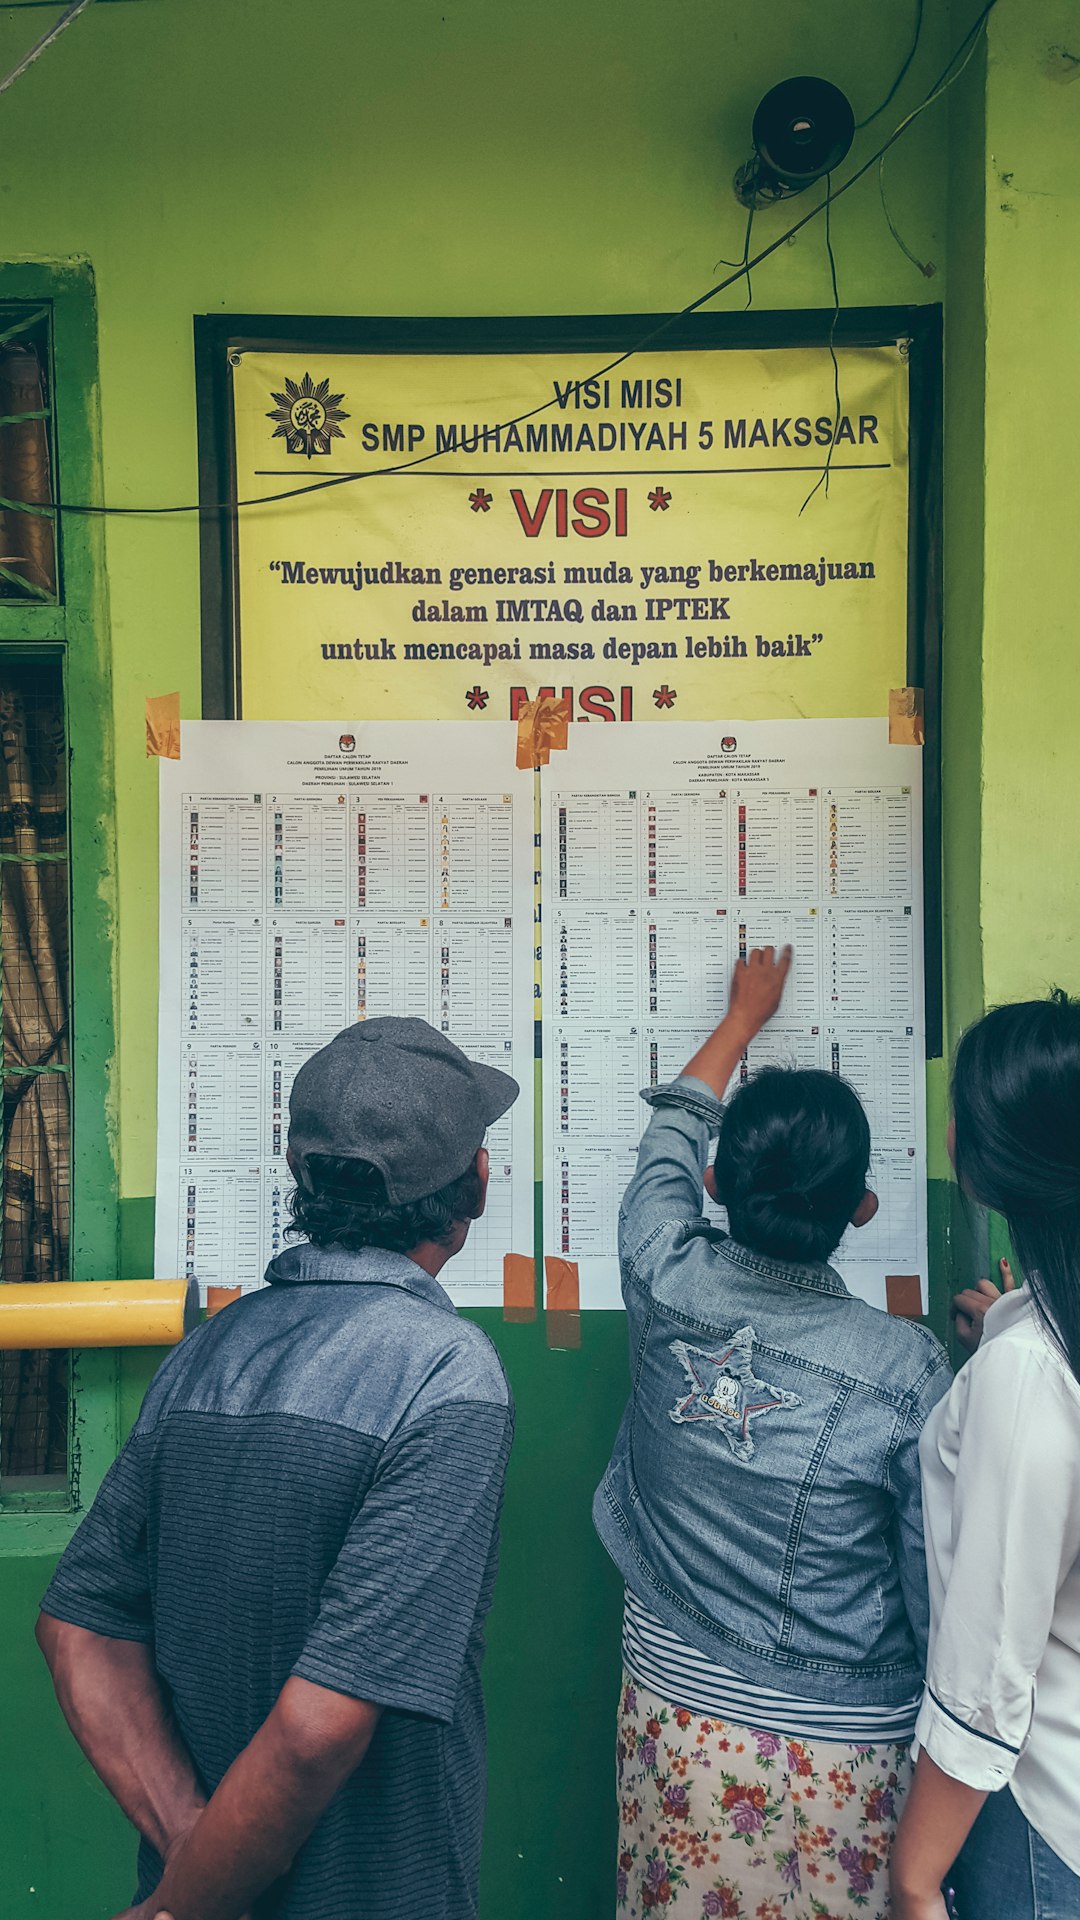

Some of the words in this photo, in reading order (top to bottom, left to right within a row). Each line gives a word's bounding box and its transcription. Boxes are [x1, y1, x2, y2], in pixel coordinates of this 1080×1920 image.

[554, 380, 610, 409] VISI
[621, 378, 682, 409] MISI
[361, 423, 426, 453] SMP
[436, 420, 687, 454] MUHAMMADIYAH
[698, 421, 714, 450] 5
[724, 415, 880, 449] MAKSSAR
[509, 487, 628, 538] VISI
[449, 561, 556, 591] generasi
[563, 560, 633, 584] muda
[639, 564, 702, 590] yang
[708, 557, 876, 587] berkemajuan
[411, 599, 488, 623] dalam
[495, 598, 584, 624] IMTAQ
[591, 599, 638, 622] dan
[644, 597, 731, 621] IPTEK
[320, 637, 397, 661] untuk
[403, 637, 522, 667] mencapai
[529, 642, 596, 662] masa
[602, 636, 678, 666] depan
[685, 635, 747, 660] lebih
